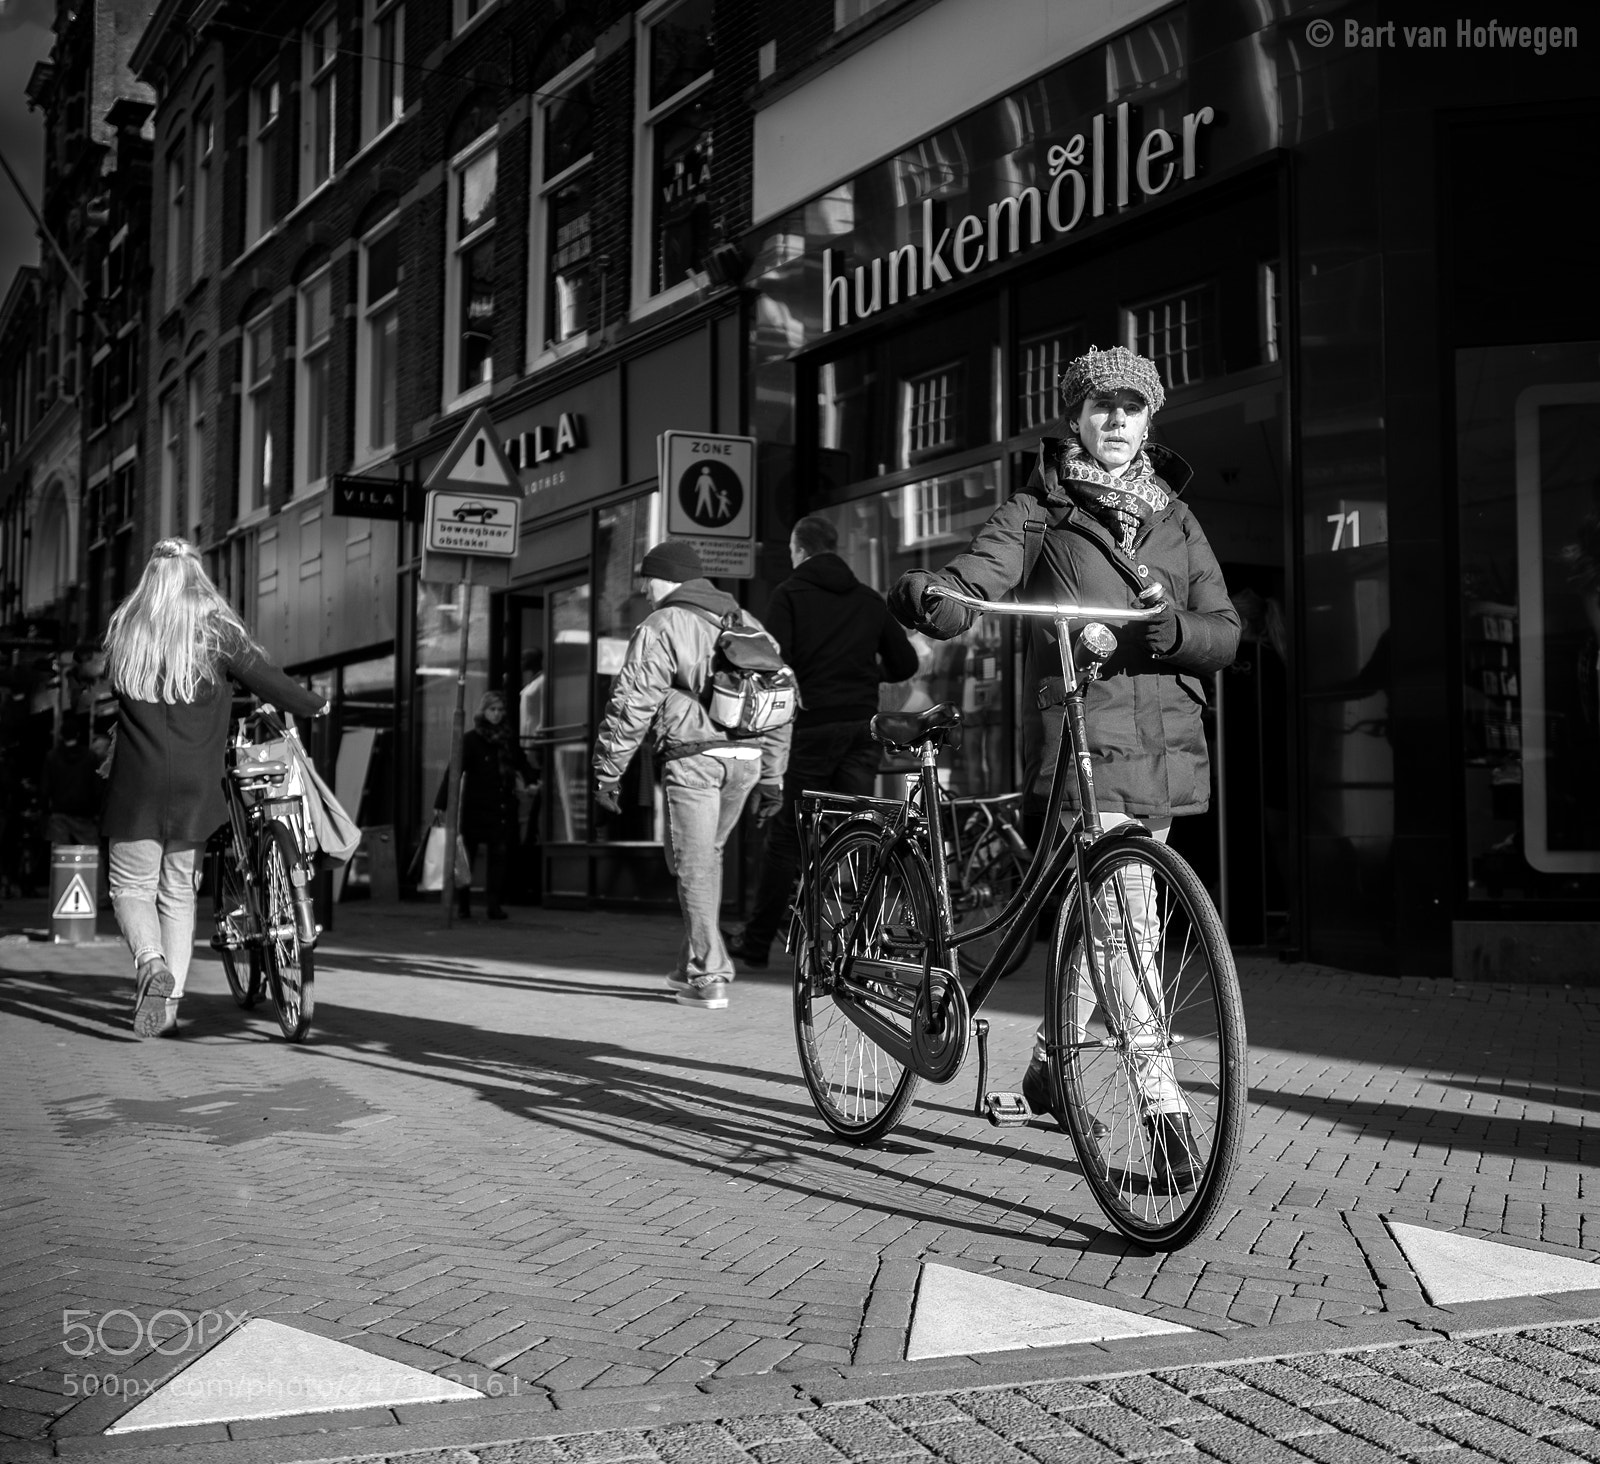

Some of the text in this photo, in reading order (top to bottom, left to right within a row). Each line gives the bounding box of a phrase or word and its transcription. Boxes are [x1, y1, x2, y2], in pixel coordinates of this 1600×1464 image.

[663, 163, 711, 203] VILA
[822, 101, 1215, 333] hunkemöller
[691, 441, 733, 456] ZONE
[524, 470, 566, 496] LOTHES
[343, 489, 395, 505] VILA
[440, 523, 509, 538] beweegbaar
[1326, 509, 1361, 552] 71
[438, 537, 489, 548] obstakel
